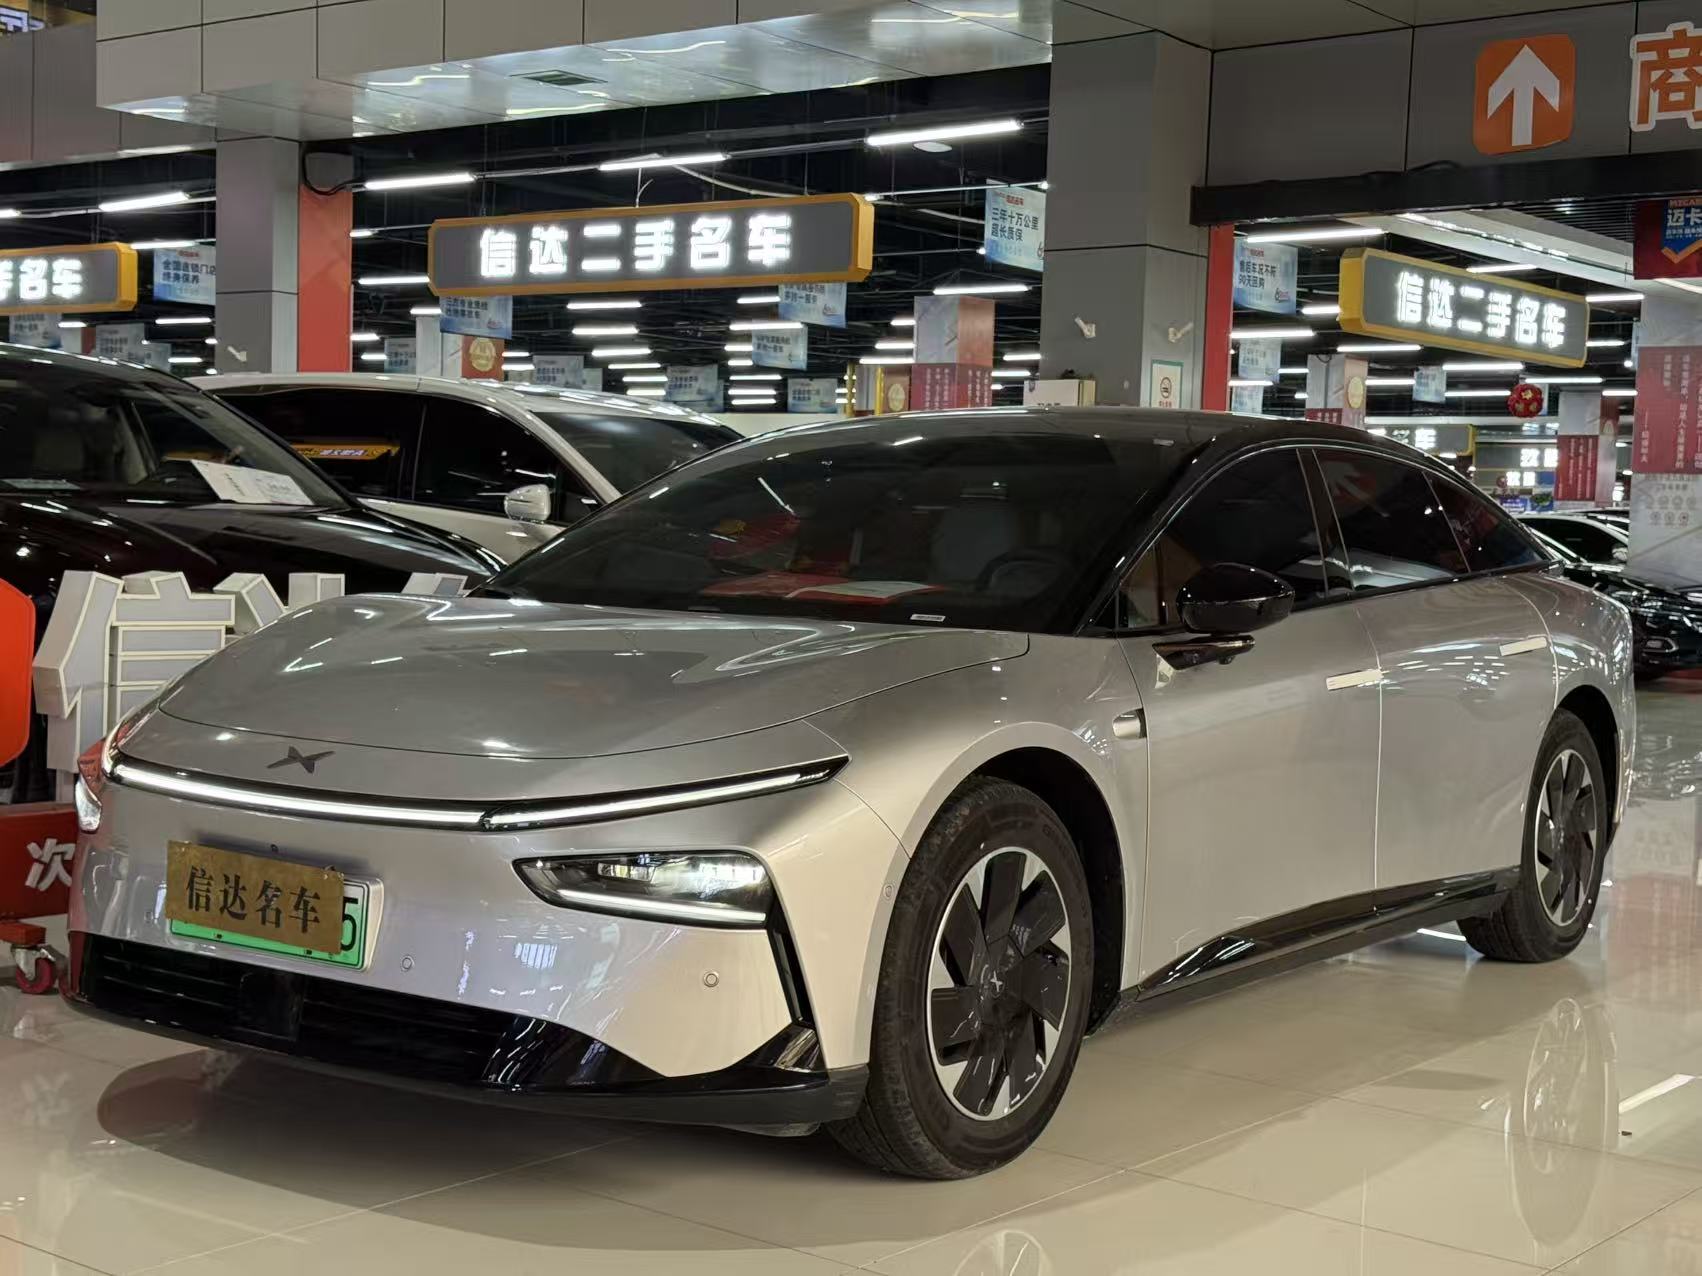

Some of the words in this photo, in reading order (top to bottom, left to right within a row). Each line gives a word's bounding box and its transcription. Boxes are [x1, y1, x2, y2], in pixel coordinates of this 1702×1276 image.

[1629, 21, 1702, 131] 商
[480, 214, 793, 277] 信达二手名车
[992, 207, 1039, 231] 三年十万公里
[1397, 271, 1567, 349] 信达二手名车
[186, 864, 321, 933] 信达名车
